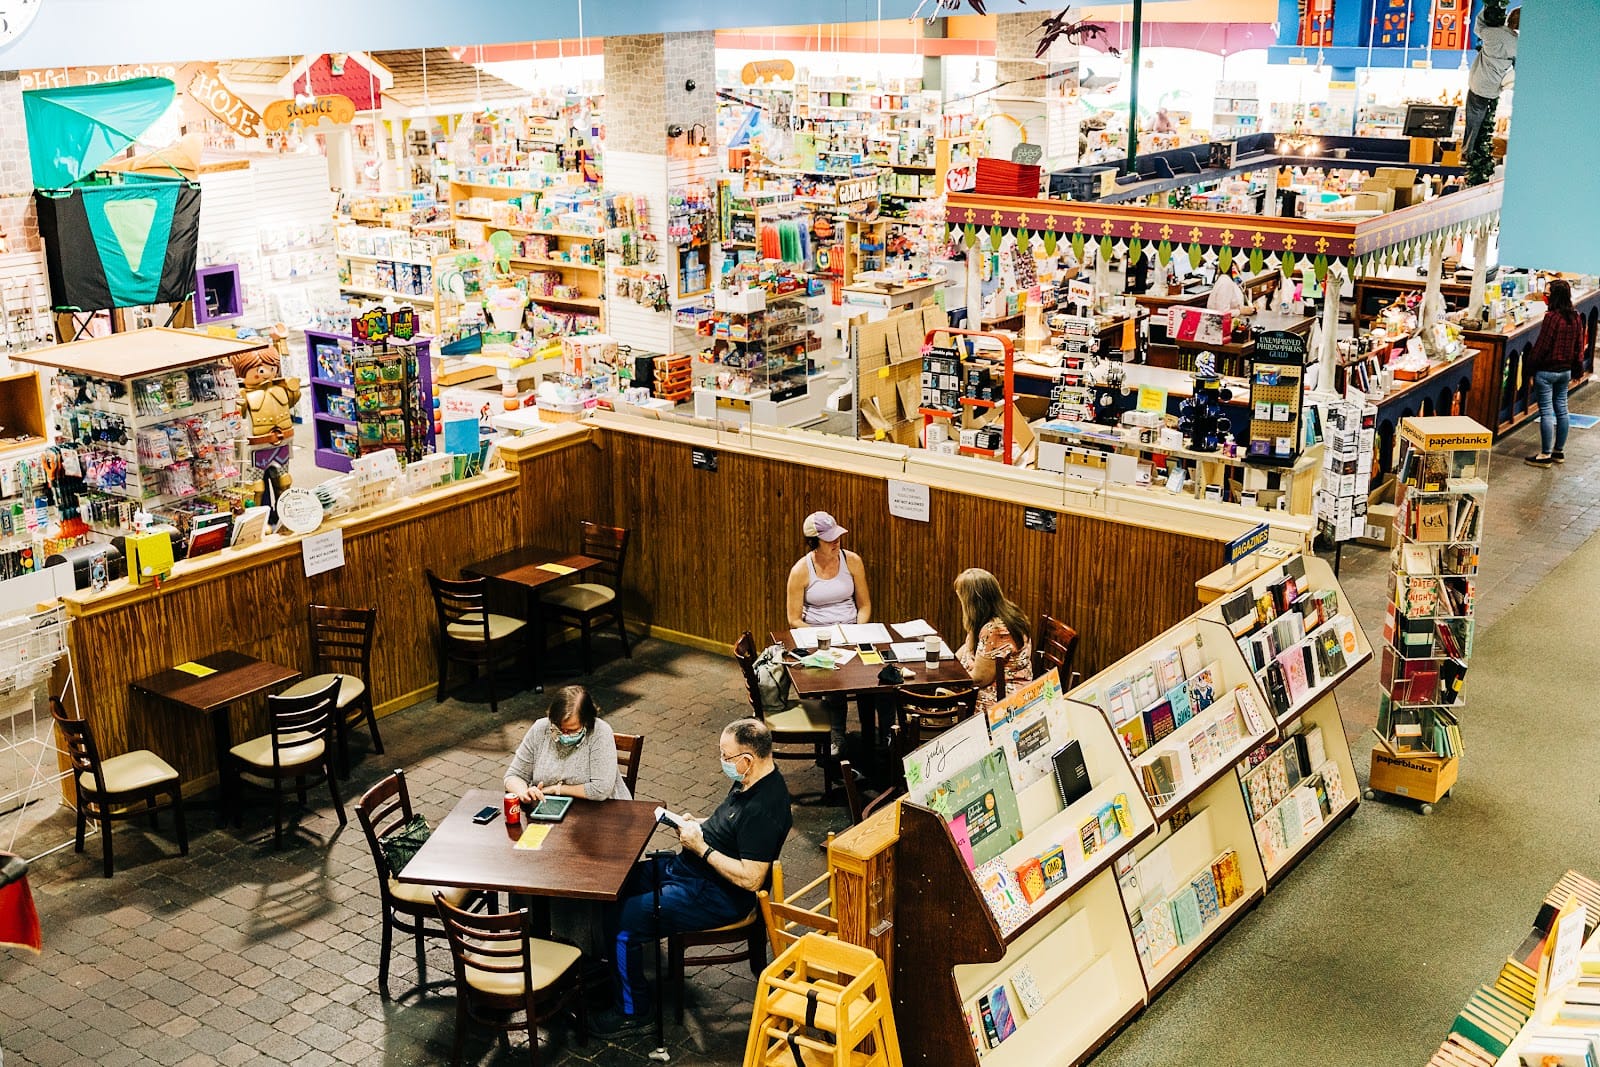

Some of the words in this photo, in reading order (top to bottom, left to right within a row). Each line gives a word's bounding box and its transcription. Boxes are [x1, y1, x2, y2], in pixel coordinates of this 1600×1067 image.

[193, 73, 256, 135] HOLE
[286, 100, 333, 118] SCIENCE
[839, 184, 862, 204] GAME
[393, 312, 413, 323] FUN
[356, 314, 392, 339] YAY!
[394, 327, 413, 338] HERE
[1256, 343, 1303, 353] PHILOSOPHERS
[1259, 336, 1301, 347] UNEMPLOYED
[1269, 350, 1289, 359] GUILD
[1429, 437, 1488, 448] paperblanks
[1231, 529, 1268, 560] MAGAZINES
[1411, 592, 1434, 602] NIGHT
[925, 737, 971, 779] july
[1377, 754, 1433, 773] paperblanks
[1046, 858, 1060, 874] OMG
